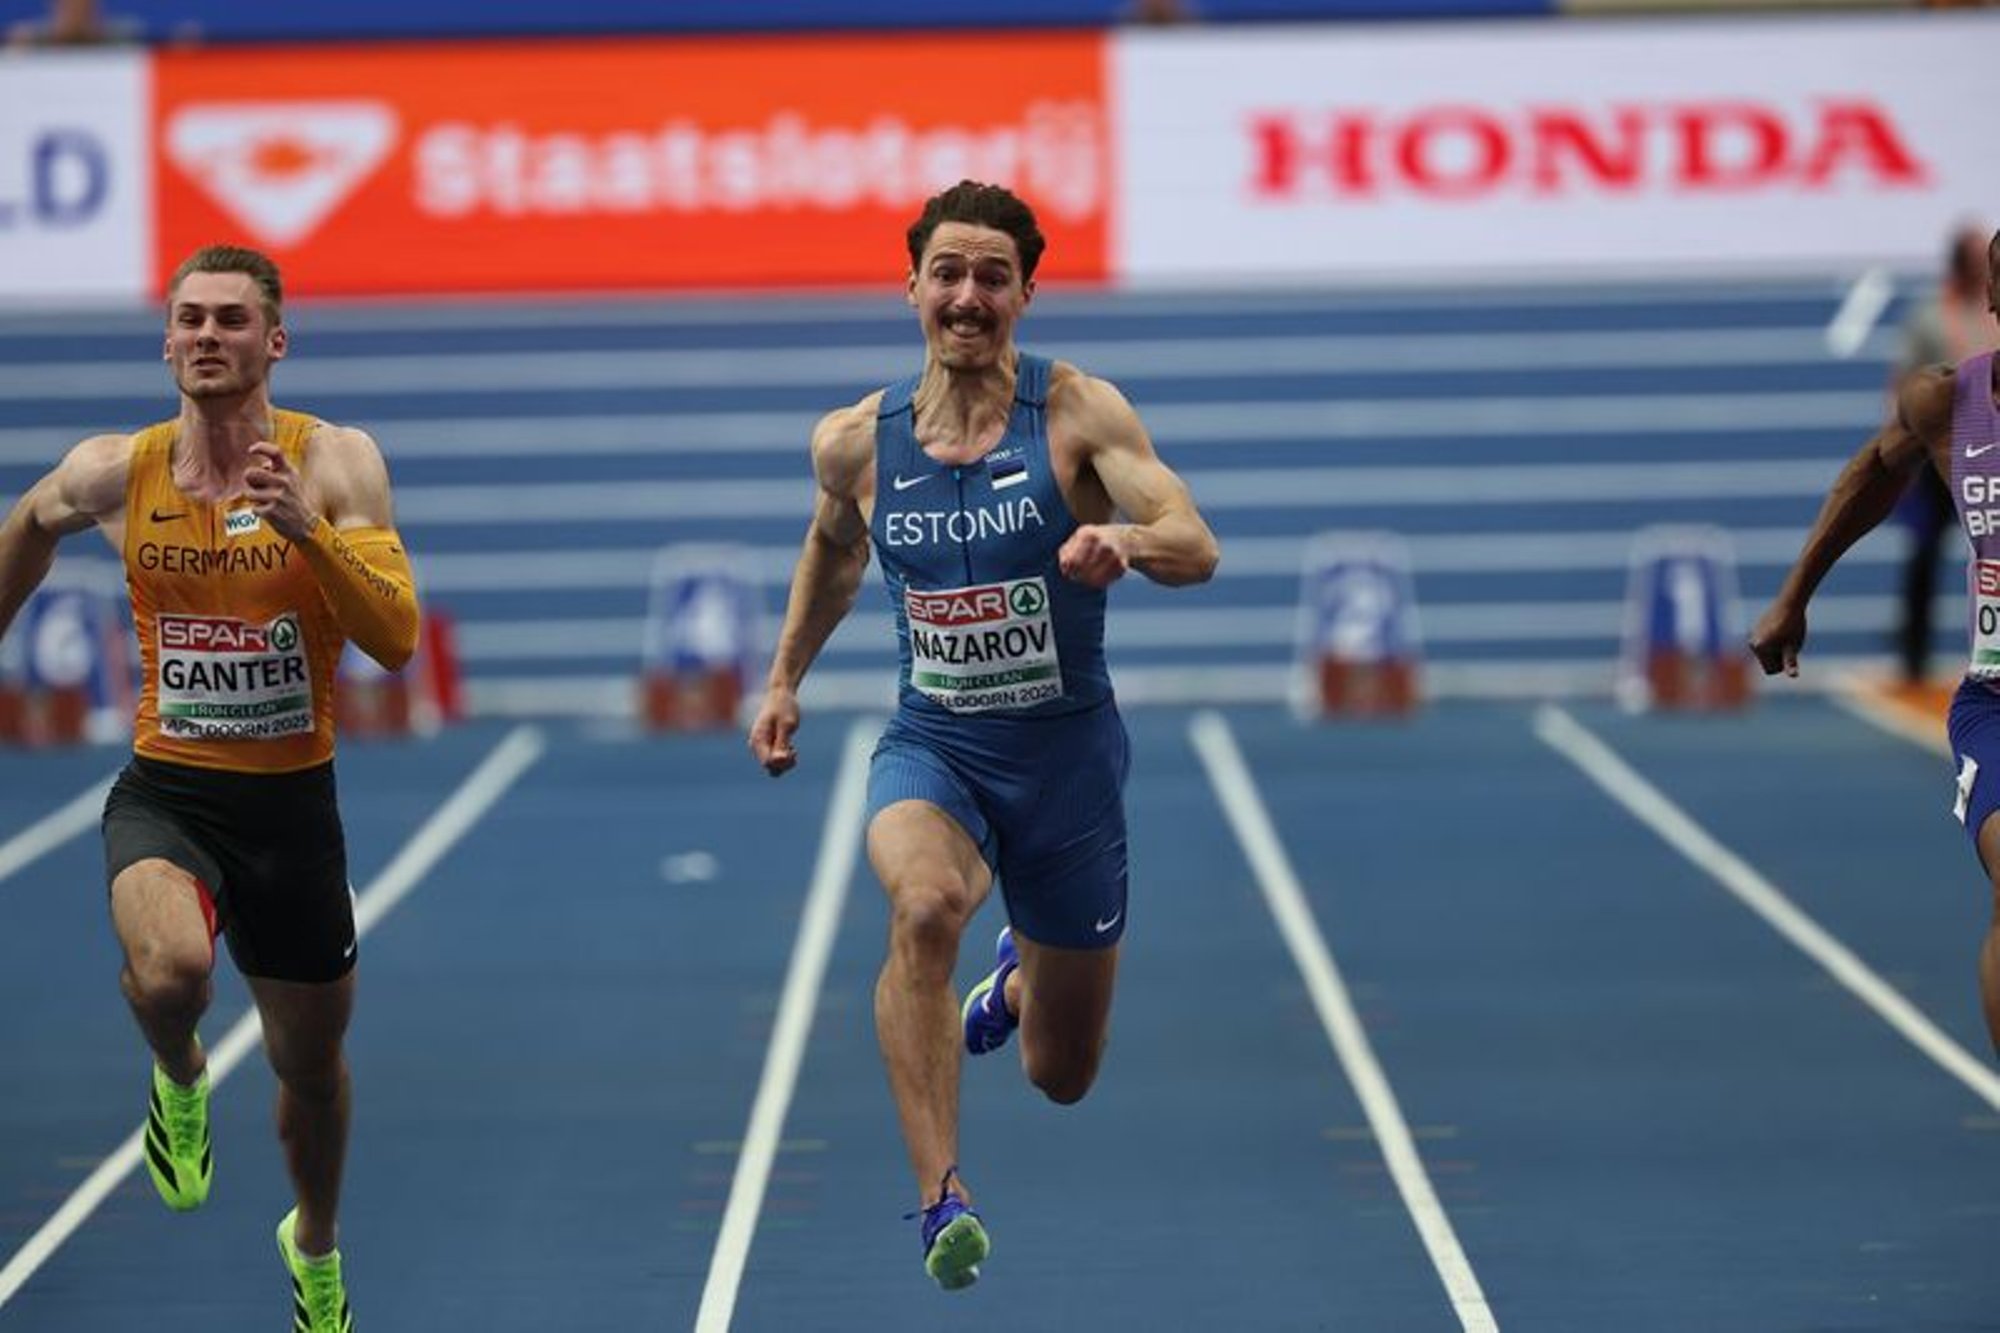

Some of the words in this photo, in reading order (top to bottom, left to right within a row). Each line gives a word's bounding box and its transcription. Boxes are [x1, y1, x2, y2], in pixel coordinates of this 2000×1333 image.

[414, 103, 1098, 222] Staatsloterij
[1248, 97, 1930, 202] HONDA
[0, 127, 112, 230] D
[885, 496, 1045, 546] ESTONIA
[138, 541, 291, 575] GERMANY
[1979, 568, 2000, 592] S
[909, 591, 1005, 622] SPAR
[1979, 604, 2000, 635] O
[163, 621, 266, 648] SPAR
[913, 622, 1047, 664] NAZAROV
[162, 656, 305, 692] GANTER
[1019, 684, 1060, 701] 2025
[270, 714, 310, 732] 2025
